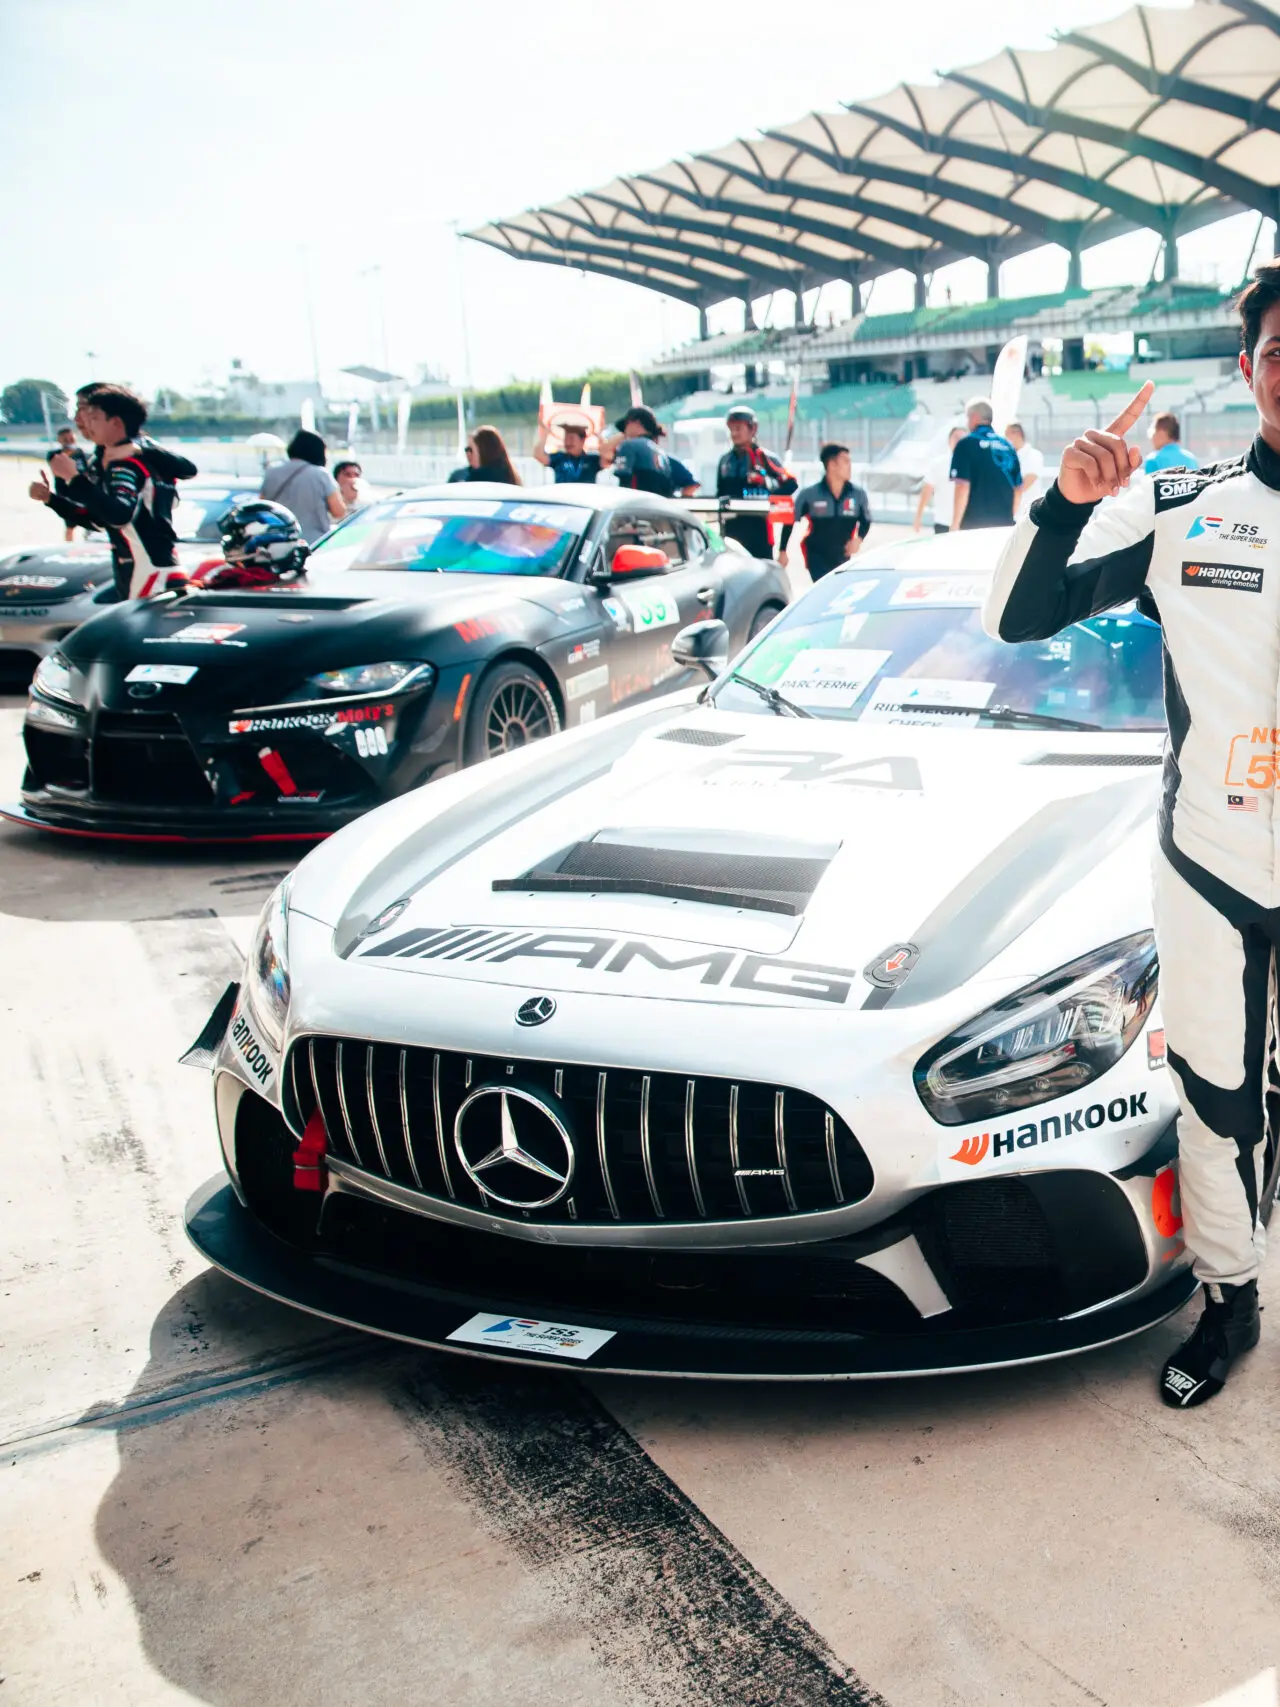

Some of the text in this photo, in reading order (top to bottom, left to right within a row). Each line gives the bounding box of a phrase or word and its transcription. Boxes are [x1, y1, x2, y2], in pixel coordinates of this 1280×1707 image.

[1160, 482, 1197, 497] OMP
[1232, 523, 1259, 536] TSS
[1230, 534, 1247, 543] SUPER
[1248, 536, 1268, 545] SERIES
[1212, 578, 1259, 589] driving emotion
[816, 680, 862, 691] FERME
[543, 1326, 580, 1337] TSS
